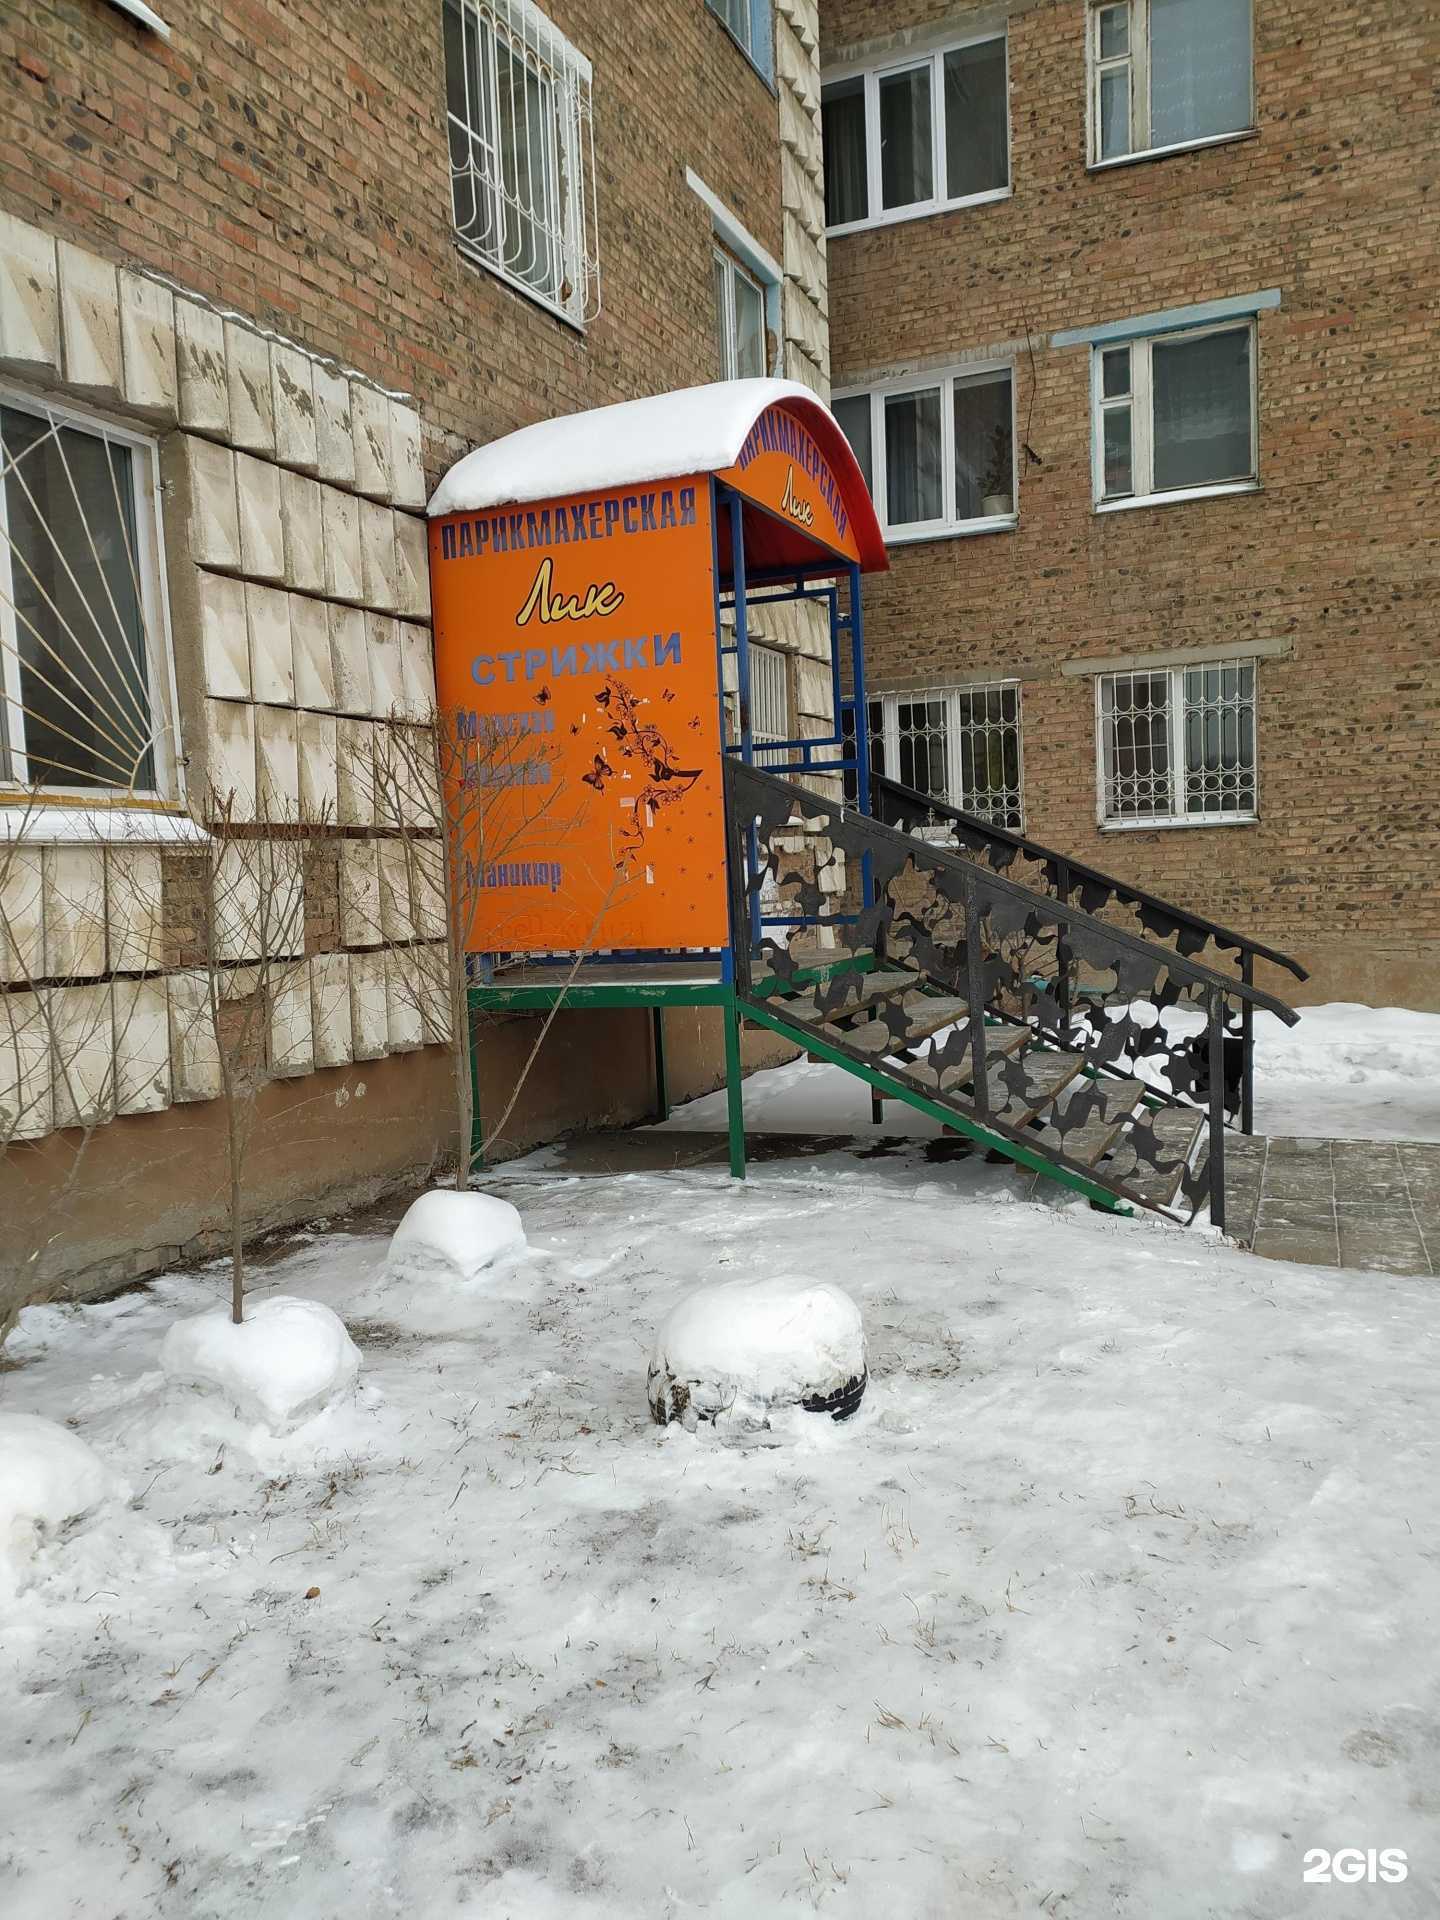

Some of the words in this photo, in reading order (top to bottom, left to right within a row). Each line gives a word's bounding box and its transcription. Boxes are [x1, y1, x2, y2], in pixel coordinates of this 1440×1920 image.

[738, 409, 848, 541] ПАРИКМАХЕРСКАЯ
[781, 464, 814, 527] Лик
[441, 486, 697, 560] ПАРИКМАХЕРСКАЯ
[515, 557, 625, 626] Лик
[470, 632, 682, 686] СТРИЖКИ
